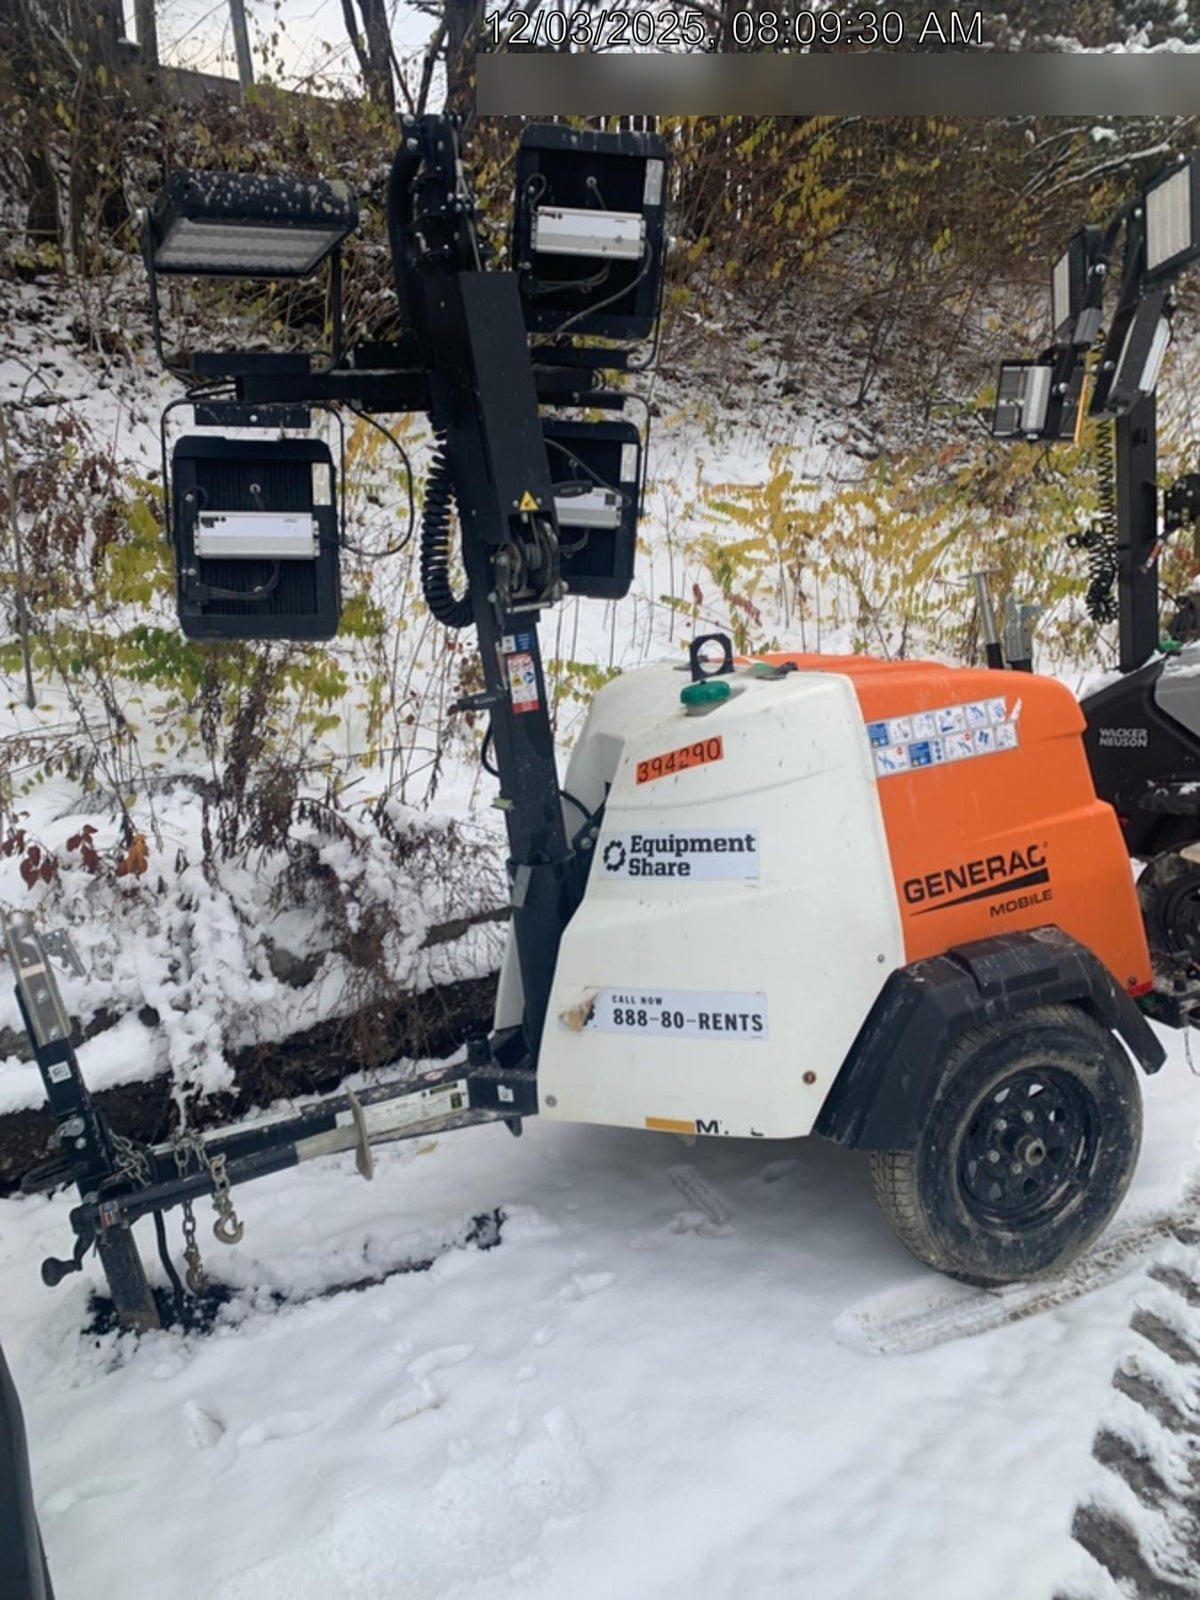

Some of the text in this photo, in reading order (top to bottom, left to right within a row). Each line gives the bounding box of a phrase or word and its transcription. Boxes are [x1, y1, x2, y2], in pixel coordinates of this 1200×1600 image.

[1099, 728, 1148, 738] WACKER
[1099, 737, 1148, 747] NEUSON
[637, 737, 721, 784] 394290
[631, 834, 757, 857] Equipment
[629, 858, 691, 877] Share
[903, 845, 1047, 904] GENERAC
[989, 889, 1052, 918] MOBILE
[612, 994, 663, 1006] CALL NOW
[613, 1007, 764, 1032] 888-80-RENTS
